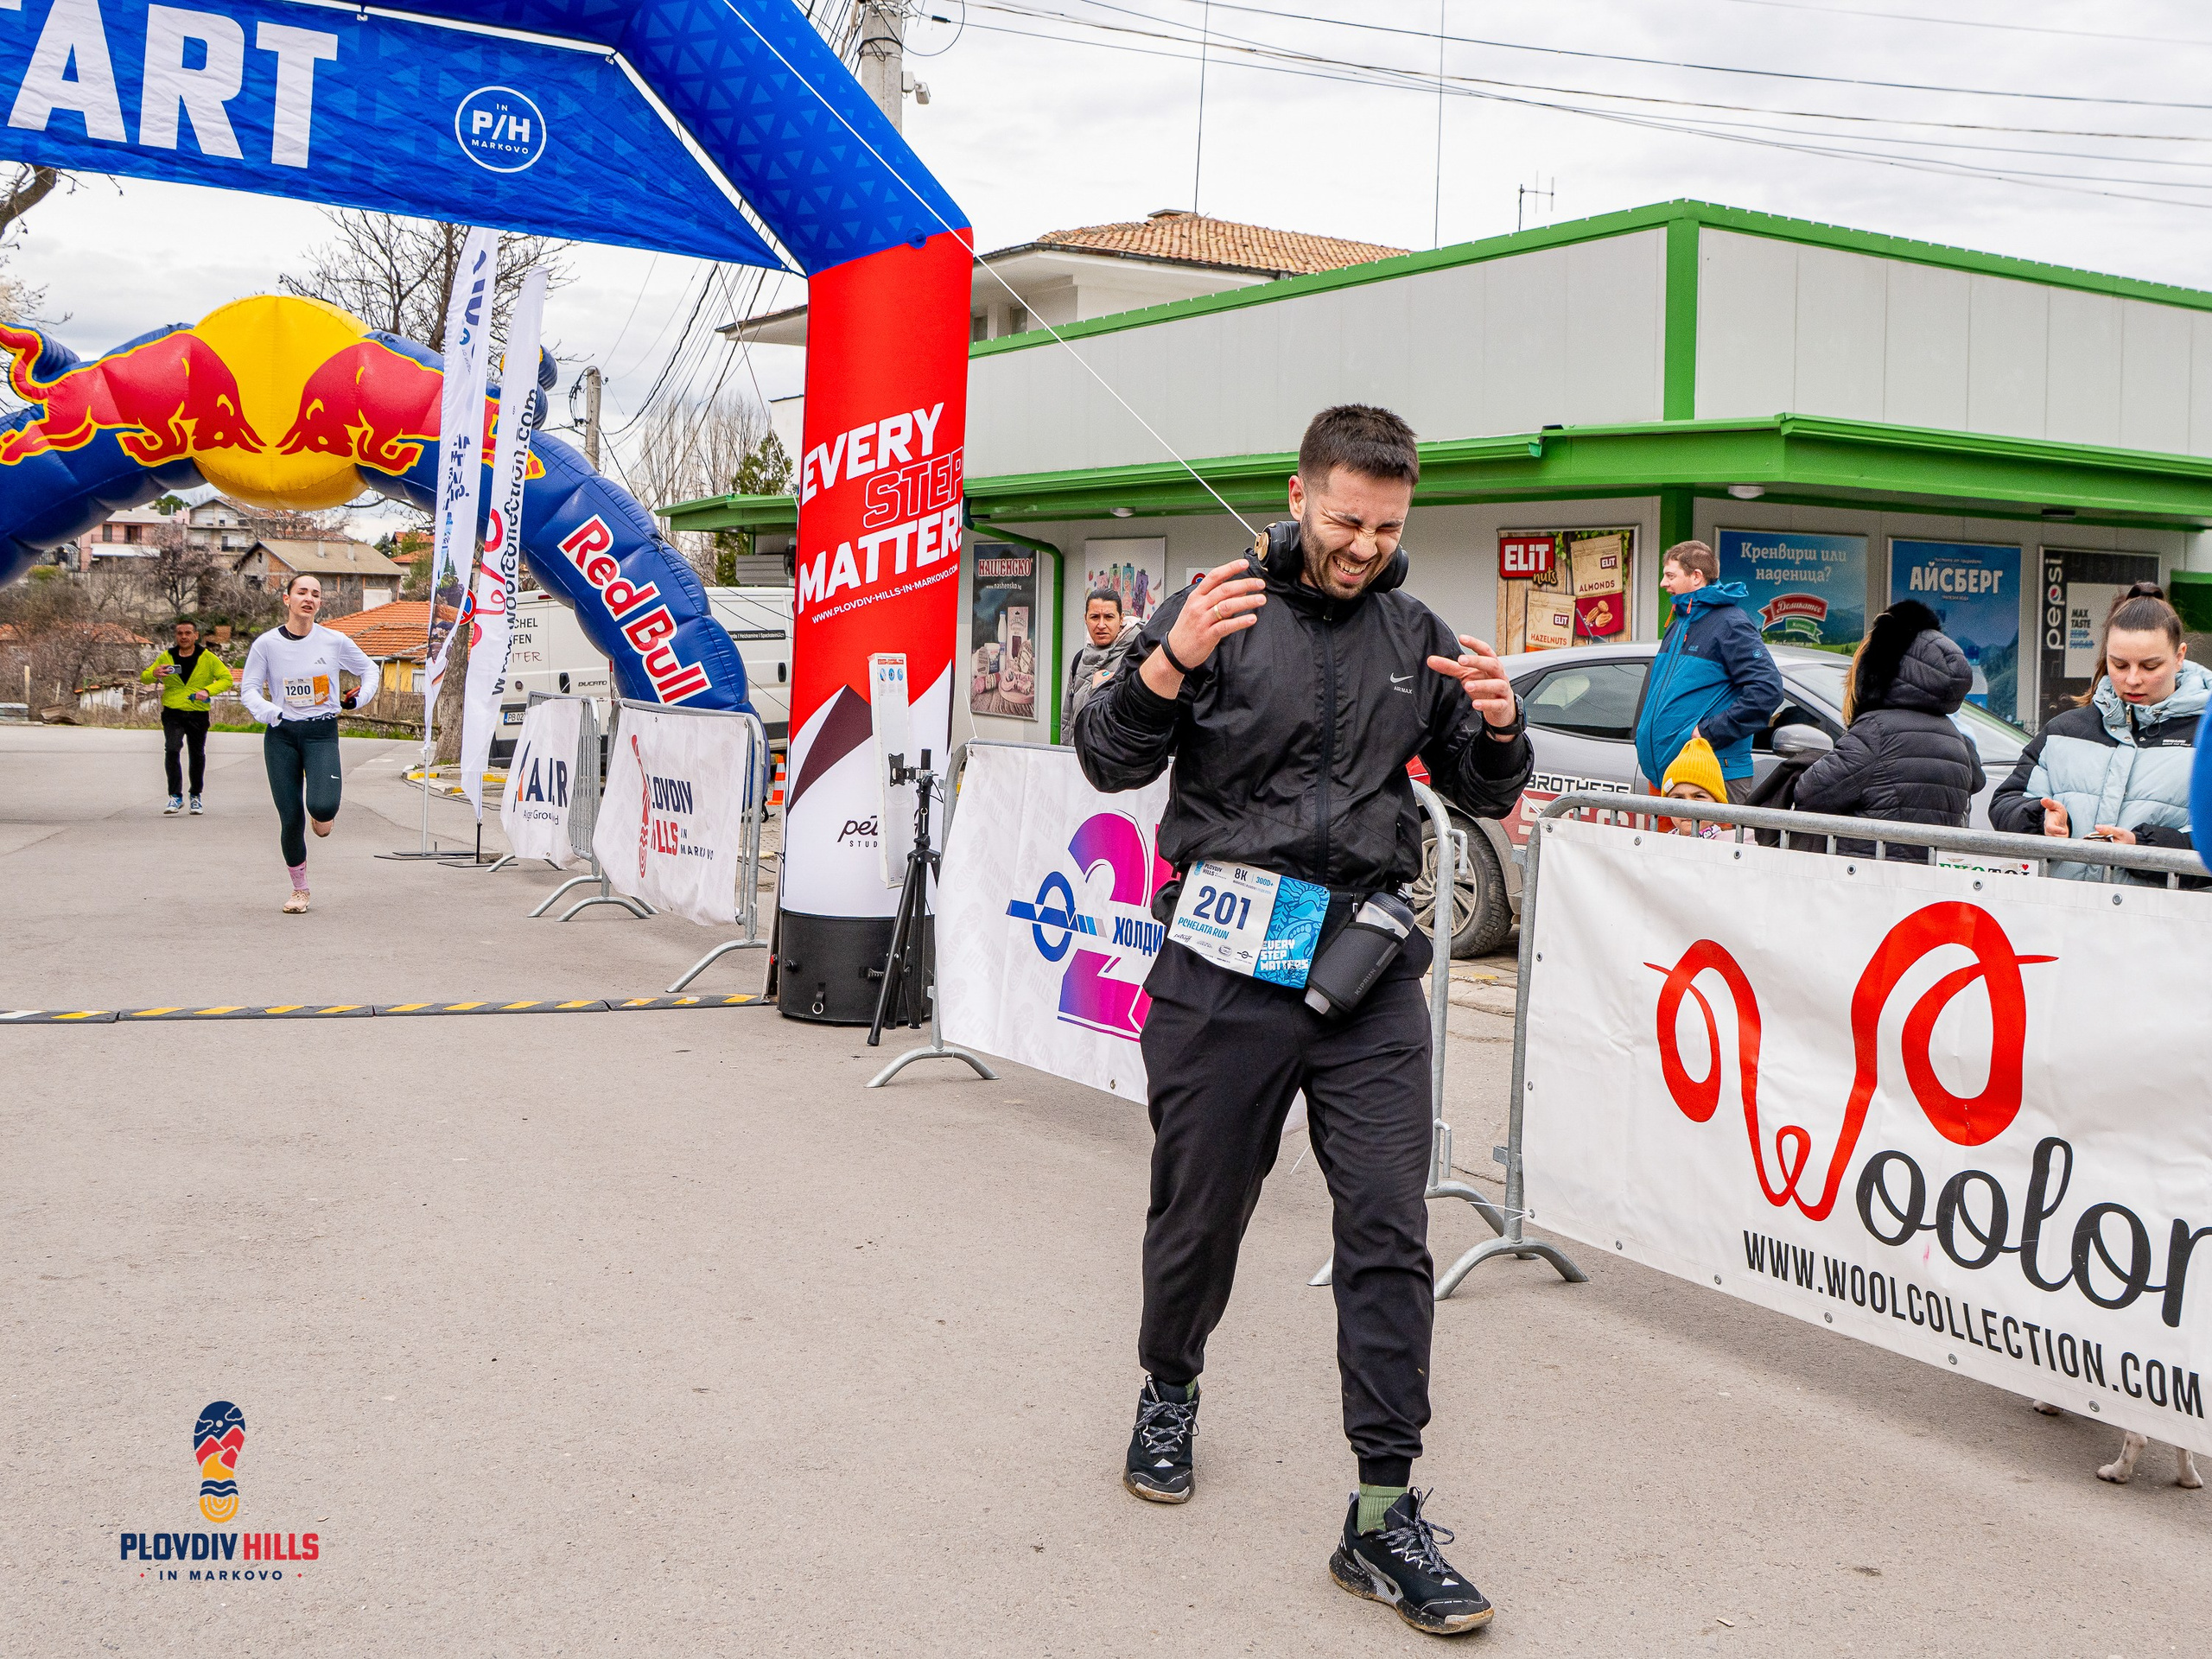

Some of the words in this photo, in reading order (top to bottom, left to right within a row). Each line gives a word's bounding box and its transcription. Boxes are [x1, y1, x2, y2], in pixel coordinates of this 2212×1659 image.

[0, 0, 338, 169] ART
[496, 103, 508, 111] IN
[472, 110, 531, 143] P/H
[471, 139, 529, 155] MARKOVO
[802, 402, 944, 507] EVERY
[863, 446, 963, 529] STEP
[1740, 542, 1817, 565] Кренвирш
[1821, 550, 1847, 563] или
[978, 557, 1032, 577] НАШЕНСКО
[1533, 566, 1557, 585] nuts
[1755, 565, 1832, 585] наденица?
[1910, 561, 2003, 594] АЙСБЕРГ
[811, 563, 958, 625] WWW.PLOVDIV-HILLS-IN-MARKOVO.COM
[1579, 579, 1615, 593] ALMONDS
[558, 515, 660, 620] Red
[621, 604, 711, 704] Bull
[2045, 556, 2065, 650] pepsi
[2071, 608, 2088, 618] MAX
[2071, 619, 2091, 628] TASTE
[1530, 633, 1567, 646] HAZELNUTS
[285, 685, 310, 696] 1200
[507, 713, 516, 721] PB
[517, 713, 525, 721] 02
[1234, 868, 1248, 881] 8K
[1255, 876, 1274, 887] 300D+
[1192, 885, 1251, 931] 201
[1112, 916, 1166, 957] ХОЛДИ
[1178, 917, 1213, 936] PCHELATA
[1212, 929, 1230, 940] RUN
[1262, 938, 1295, 950] EVERY
[1260, 950, 1287, 961] STEP
[1354, 968, 1376, 995] KIPRUN
[1743, 1230, 2205, 1420] WWW.WOOLCOLLECTION.COM
